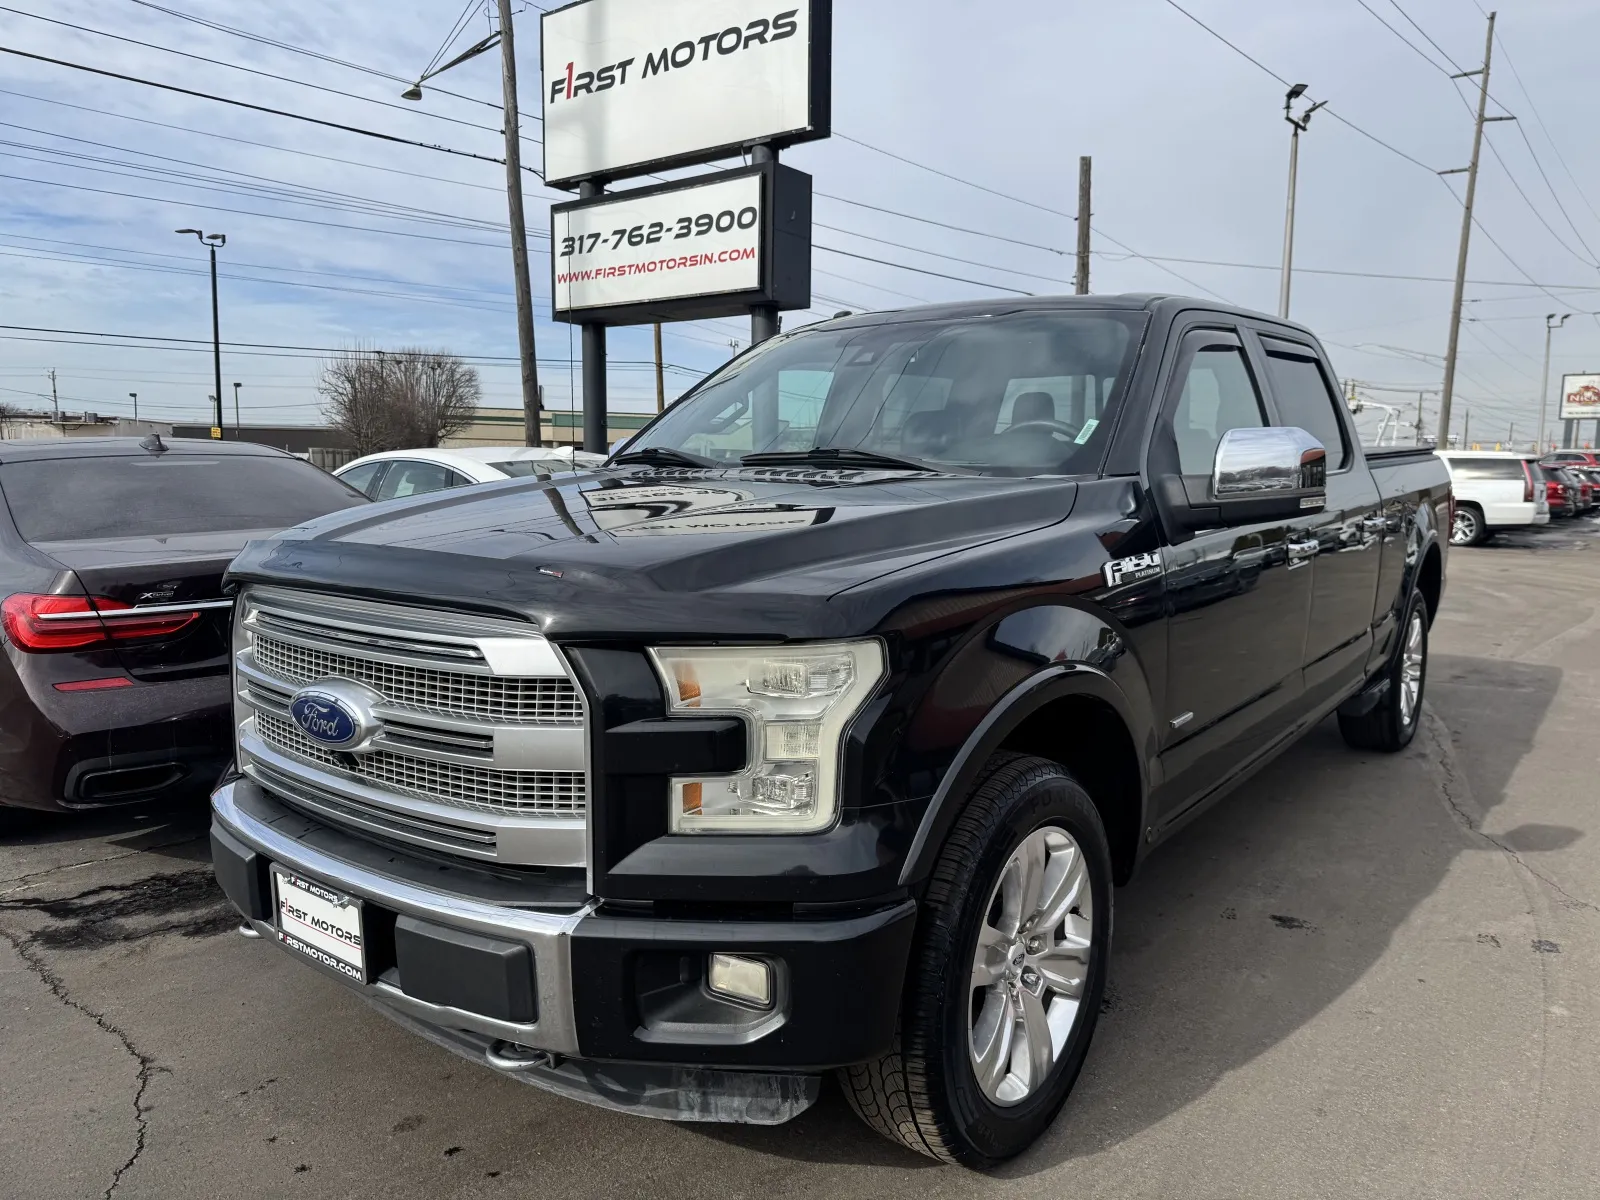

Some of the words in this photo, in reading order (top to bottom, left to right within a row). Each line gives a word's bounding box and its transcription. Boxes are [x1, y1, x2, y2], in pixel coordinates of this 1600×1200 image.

[641, 9, 799, 79] MOTORS
[560, 206, 758, 257] 317-762-3900
[557, 247, 755, 284] WWW.FIRSTMOTORSIN.COM
[1135, 567, 1160, 578] PLATINUM
[302, 703, 339, 736] Ford
[310, 885, 338, 902] MOTORS
[311, 916, 361, 945] MOTORS
